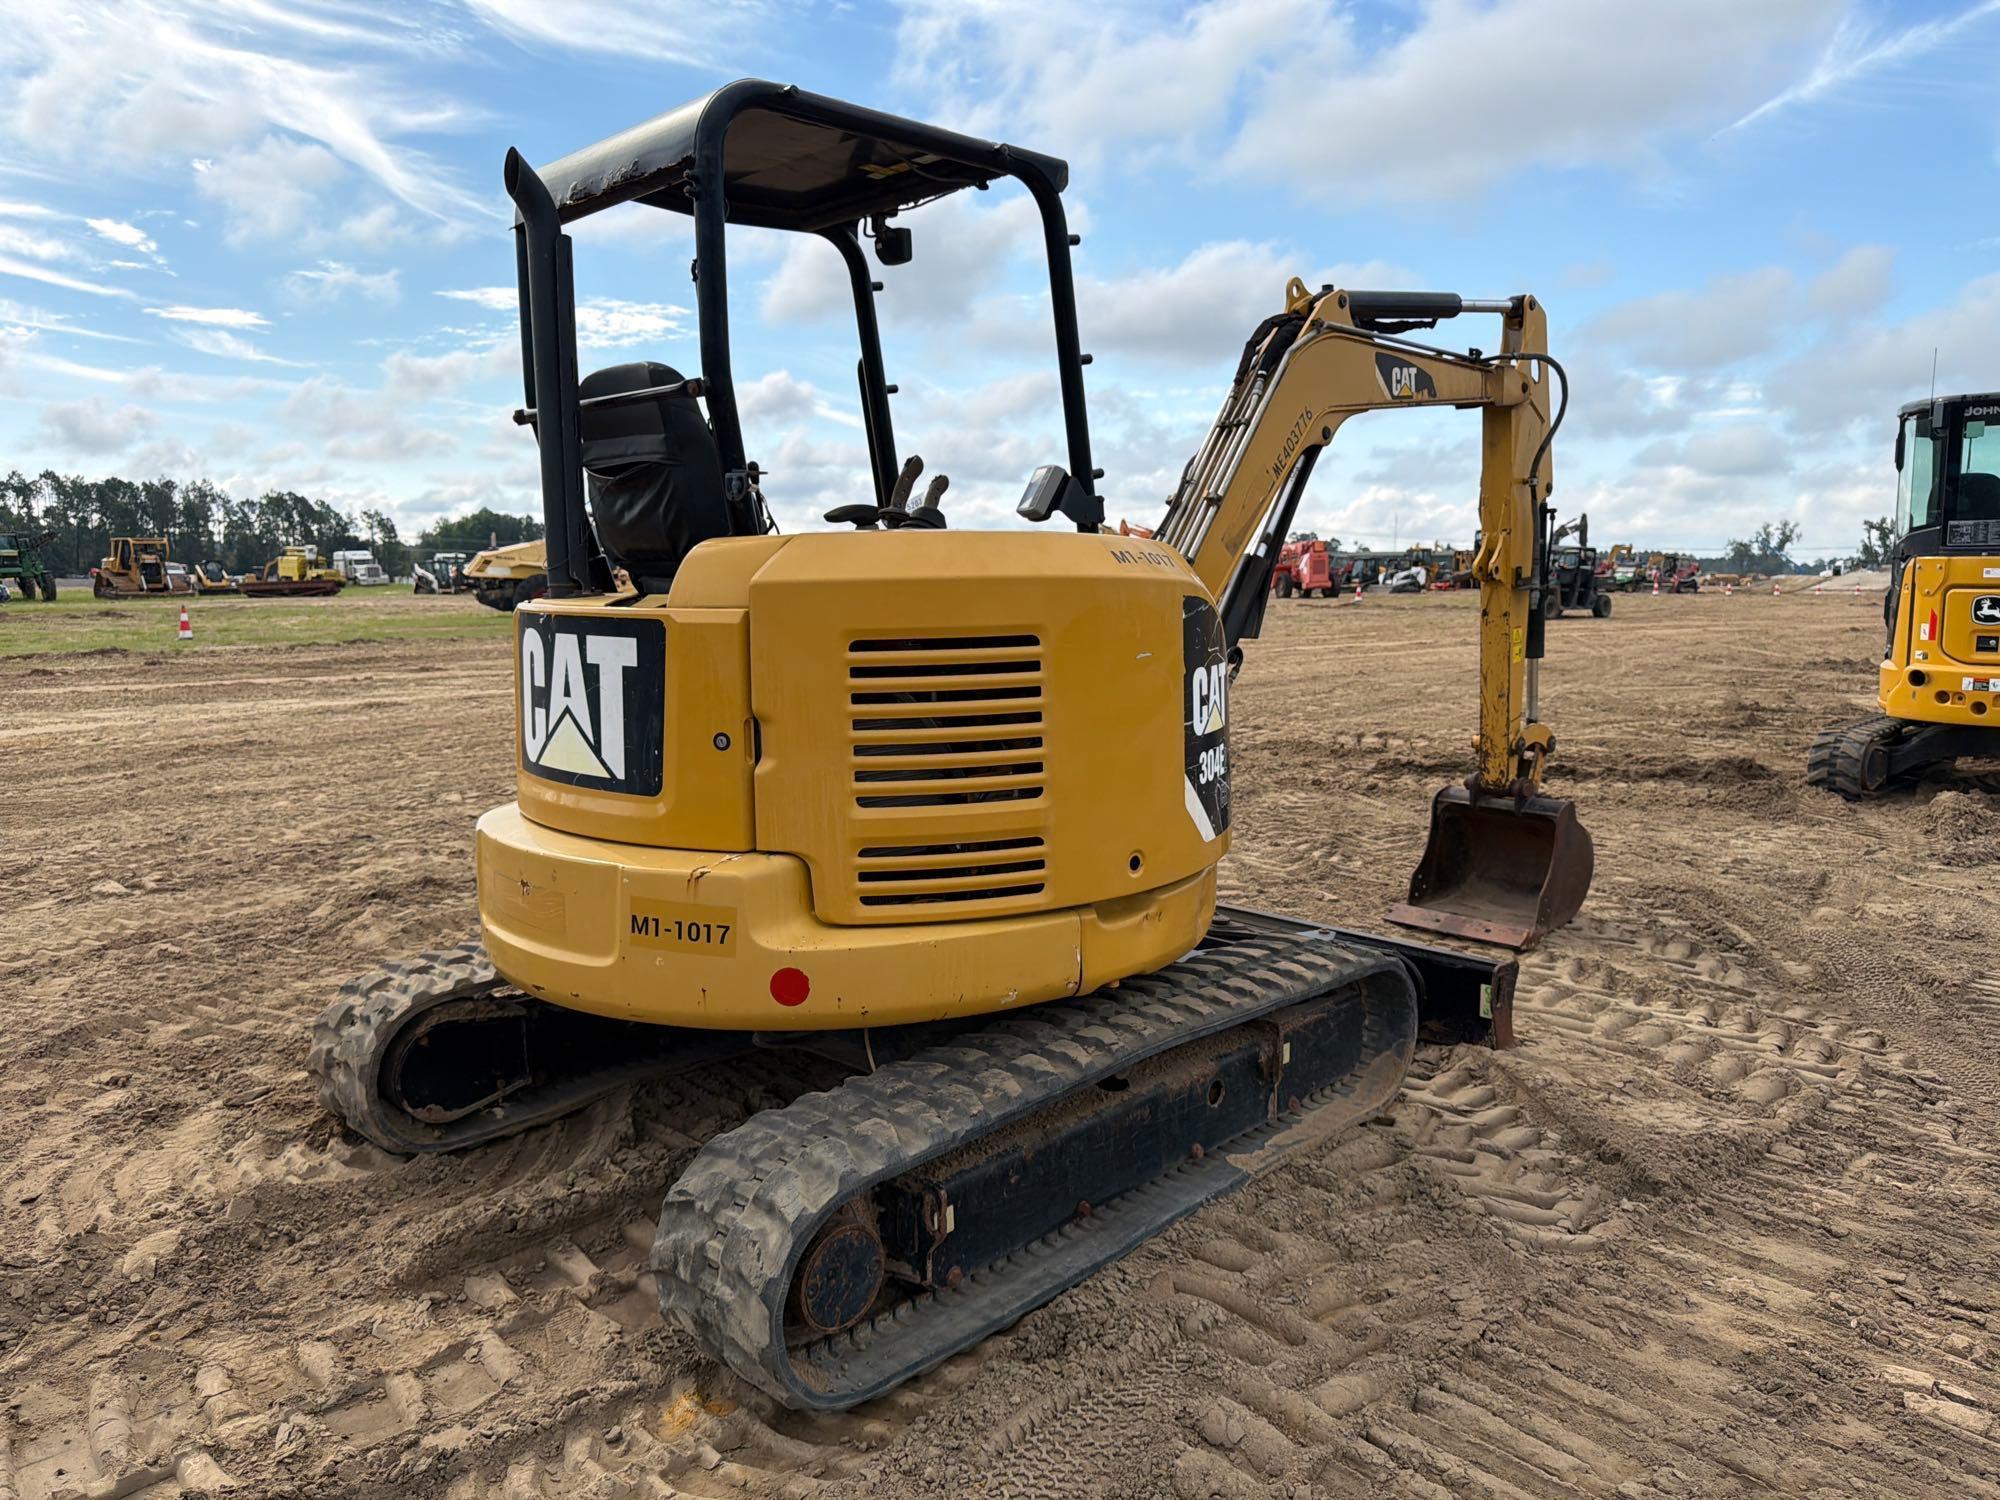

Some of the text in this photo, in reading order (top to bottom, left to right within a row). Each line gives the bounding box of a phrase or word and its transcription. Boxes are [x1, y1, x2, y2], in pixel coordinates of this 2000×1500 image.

[1392, 366, 1417, 397] CAT
[1272, 405, 1313, 479] ME403776
[1110, 550, 1175, 567] M1-1017
[522, 627, 638, 780] CAT
[1192, 662, 1226, 736] CAT
[631, 913, 731, 945] M1-1017
